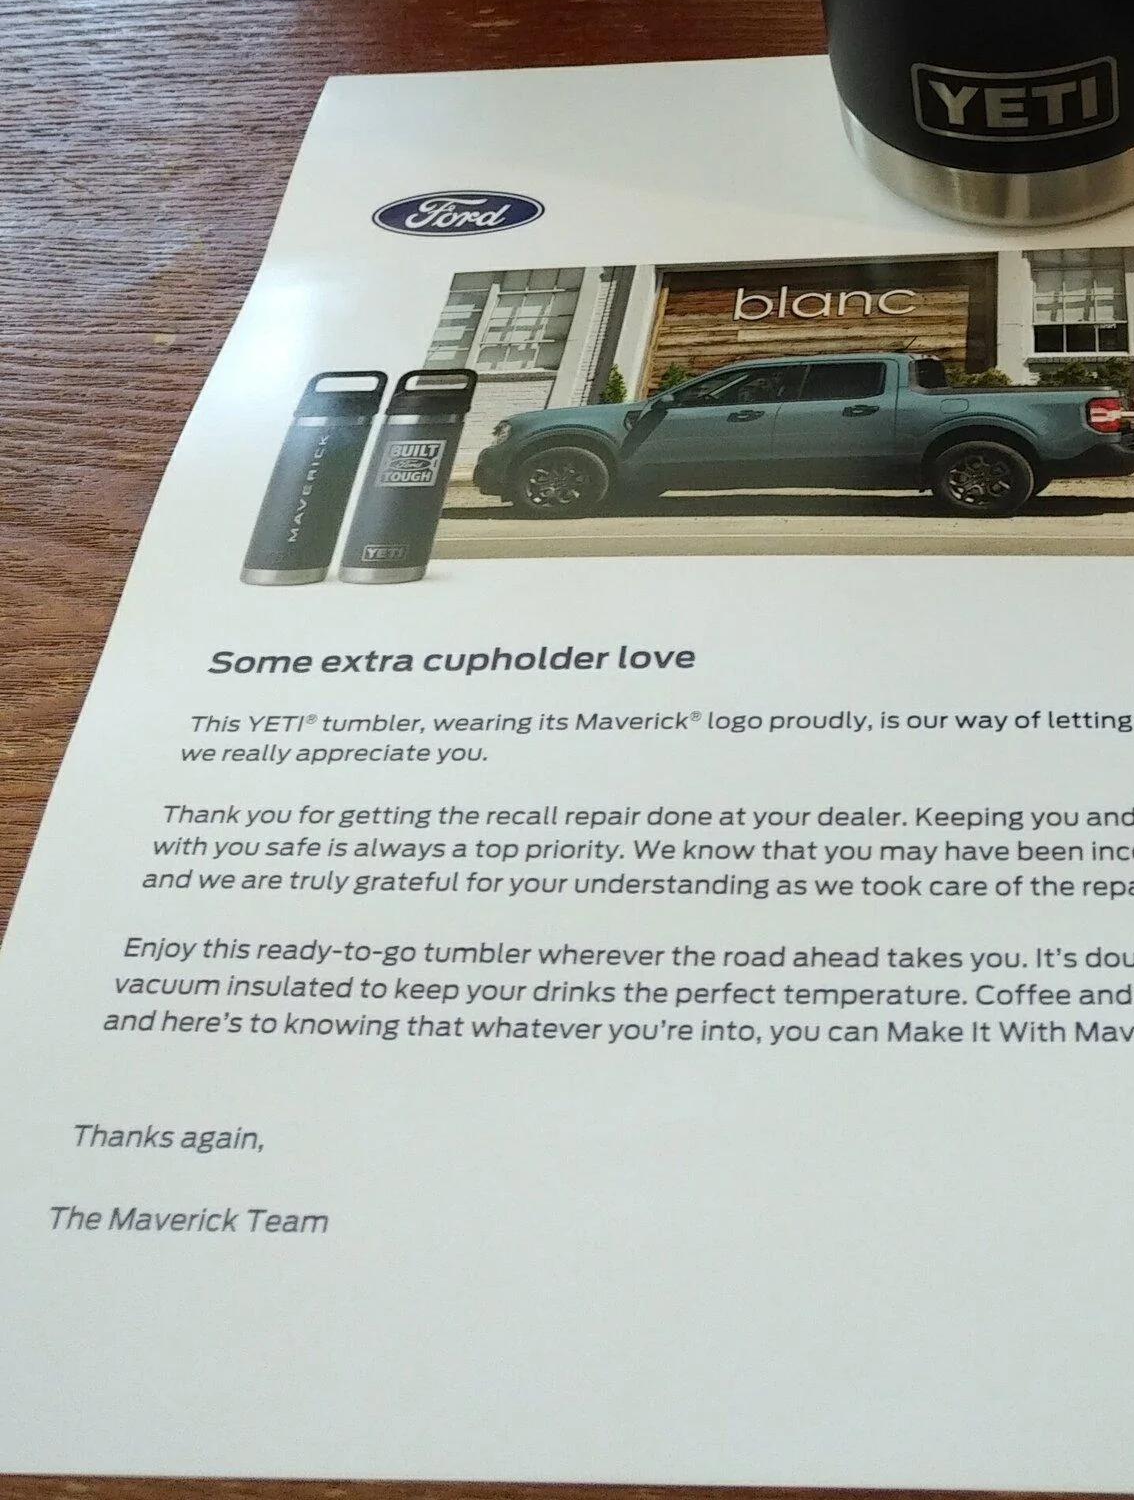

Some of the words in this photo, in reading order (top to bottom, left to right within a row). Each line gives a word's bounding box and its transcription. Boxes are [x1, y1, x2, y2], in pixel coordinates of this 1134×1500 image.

[929, 76, 1098, 128] YETI
[405, 198, 510, 229] Ford
[733, 285, 917, 321] blanc
[389, 444, 440, 458] BUILT
[287, 435, 331, 543] MAVERICK
[383, 471, 433, 483] TOUGH
[206, 650, 314, 675] Some
[319, 649, 414, 674] extra
[422, 645, 611, 677] cupholder
[617, 644, 697, 670] love
[190, 714, 242, 733] This
[322, 713, 426, 735] tumbler,
[433, 713, 534, 735] wearing
[538, 713, 570, 731] its
[707, 711, 763, 734] logo
[768, 710, 873, 733] proudly,
[880, 710, 901, 730] is
[905, 714, 949, 730] our
[954, 714, 1009, 733] way
[1014, 709, 1042, 730] of
[1047, 710, 1134, 733] letting
[181, 747, 217, 762] we
[220, 743, 293, 766] really
[295, 743, 432, 766] appreciate
[435, 747, 489, 766] you.
[163, 804, 243, 824] Thank
[244, 809, 293, 828] you
[298, 804, 336, 825] for
[337, 805, 433, 830] getting
[437, 805, 481, 826] the
[485, 805, 559, 826] recall
[564, 806, 642, 830] repair
[646, 805, 713, 827] done
[718, 807, 747, 827] at
[752, 810, 812, 831] your
[816, 805, 908, 827] dealer.
[915, 806, 1025, 832] Keeping
[1029, 811, 1080, 831] you
[153, 835, 209, 856] with
[212, 840, 261, 860] you
[264, 836, 322, 857] safe
[326, 837, 349, 858] is
[353, 837, 447, 862] always
[451, 842, 468, 859] a
[474, 839, 520, 863] top
[524, 839, 625, 864] priority.
[632, 839, 677, 860] We
[682, 838, 756, 861] know
[761, 839, 819, 861] that
[823, 844, 873, 865] you
[879, 844, 939, 866] may
[944, 839, 1010, 862] have
[1016, 839, 1084, 862] been
[141, 868, 194, 889] and
[198, 873, 237, 890] we
[240, 873, 283, 890] are
[289, 869, 351, 895] truly
[352, 870, 460, 896] grateful
[465, 871, 505, 893] for
[508, 877, 569, 898] your
[574, 872, 770, 901] understanding
[775, 879, 808, 896] as
[813, 879, 855, 897] we
[860, 874, 923, 897] took
[928, 879, 989, 897] care
[994, 874, 1024, 897] of
[1029, 874, 1076, 897] the
[123, 936, 199, 963] Enjoy
[202, 937, 252, 960] this
[255, 938, 417, 967] ready-to-go
[423, 941, 533, 965] tumbler
[537, 943, 666, 967] wherever
[670, 944, 716, 967] the
[722, 945, 787, 968] road
[792, 945, 880, 969] ahead
[886, 946, 964, 969] takes
[969, 951, 1028, 973] you.
[1036, 947, 1078, 969] It's
[114, 977, 221, 996] vacuum
[226, 974, 355, 999] insulated
[359, 977, 389, 1000] to
[393, 977, 460, 1005] keep
[464, 983, 528, 1005] your
[532, 979, 617, 1004] drinks
[622, 980, 669, 1004] the
[674, 981, 777, 1009] perfect
[782, 984, 968, 1010] temperature.
[975, 983, 1072, 1006] Coffee
[1078, 983, 1133, 1006] and
[102, 1009, 158, 1032] and
[160, 1009, 244, 1034] here's
[249, 1012, 278, 1035] to
[283, 1011, 401, 1042] knowing
[406, 1014, 466, 1038] that
[470, 1015, 604, 1040] whatever
[607, 1019, 694, 1045] you're
[700, 1019, 762, 1045] into,
[769, 1024, 821, 1046] you
[827, 1024, 879, 1043] can
[886, 1020, 965, 1043] Make
[971, 1020, 992, 1043] It
[998, 1020, 1067, 1044] With
[73, 1123, 176, 1149] Thanks
[179, 1126, 265, 1155] again,
[49, 1204, 103, 1231] The
[107, 1206, 240, 1233] Maverick
[246, 1208, 330, 1234] Team
